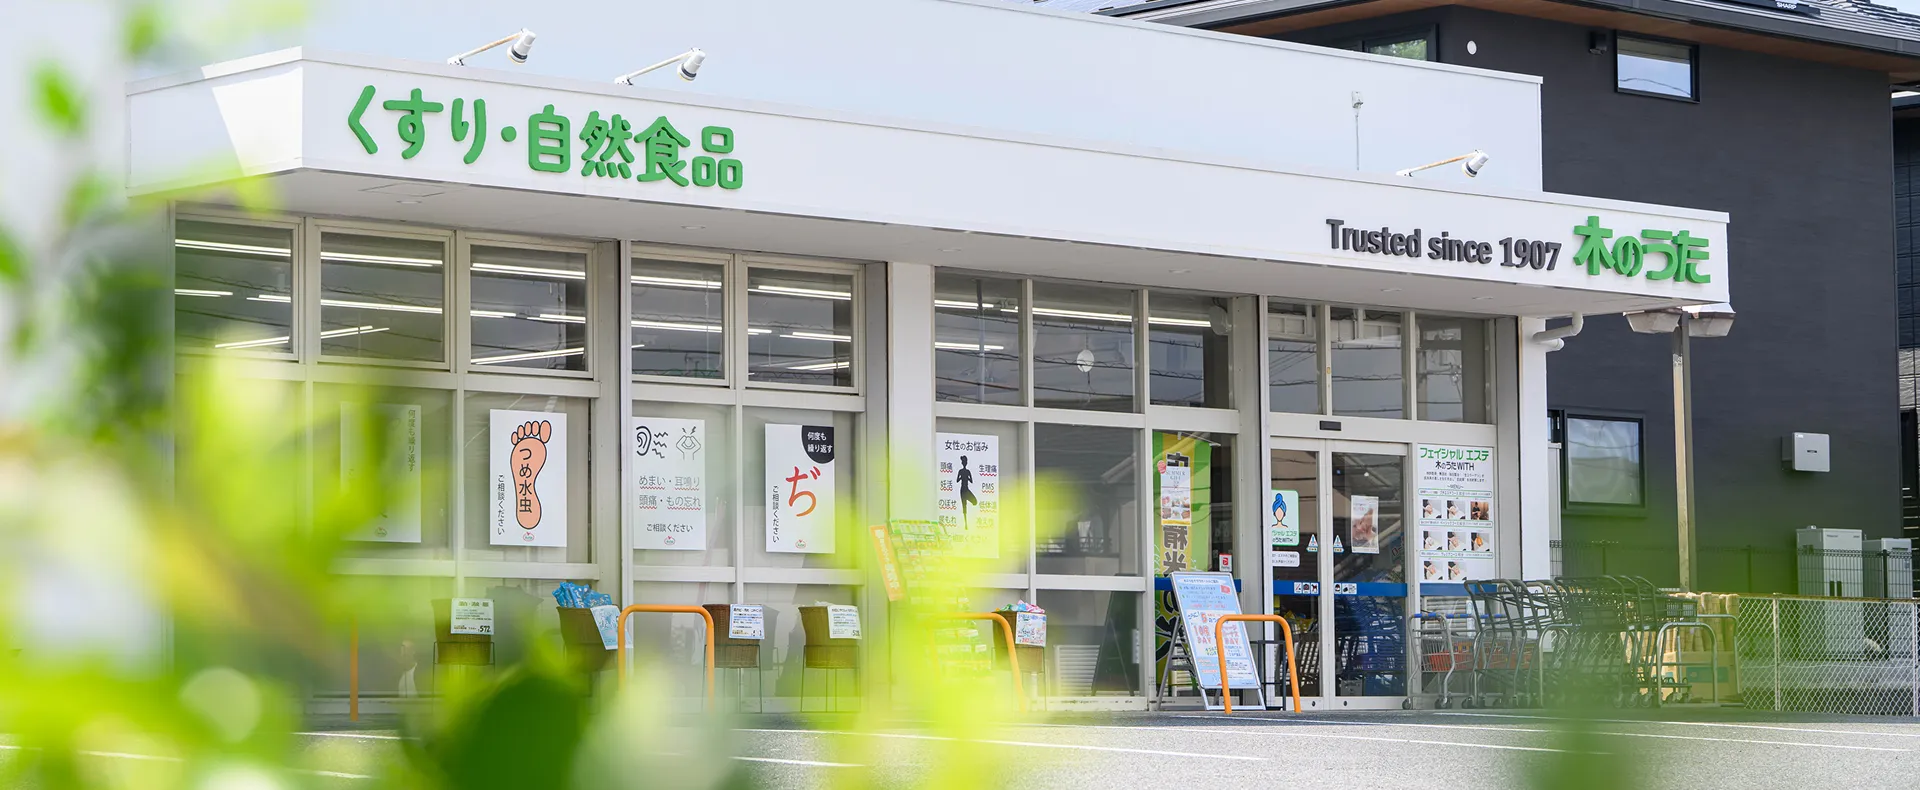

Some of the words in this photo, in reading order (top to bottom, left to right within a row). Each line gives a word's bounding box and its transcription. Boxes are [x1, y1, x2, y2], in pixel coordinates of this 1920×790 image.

[348, 85, 743, 190] くすり・自然食品
[1326, 219, 1422, 258] Trusted
[1427, 231, 1492, 264] since
[1499, 237, 1562, 271] 1907
[1573, 215, 1711, 284] 木のうた
[807, 431, 827, 441] 何度も
[807, 444, 833, 454] 繰り返す
[944, 439, 989, 451] 女性のお悩み
[1420, 447, 1463, 460] フェイシャル
[1466, 450, 1489, 461] エステ
[940, 461, 953, 470] 頭痛
[979, 464, 997, 473] 生理痛
[1435, 461, 1475, 470] 木のうたWITH
[519, 447, 532, 513] つめ水虫
[981, 482, 995, 490] PMS
[786, 466, 821, 517] ぢ
[497, 474, 505, 535] ご相談ください
[772, 485, 780, 543] ご相談ください
[646, 523, 694, 533] ご相談ください
